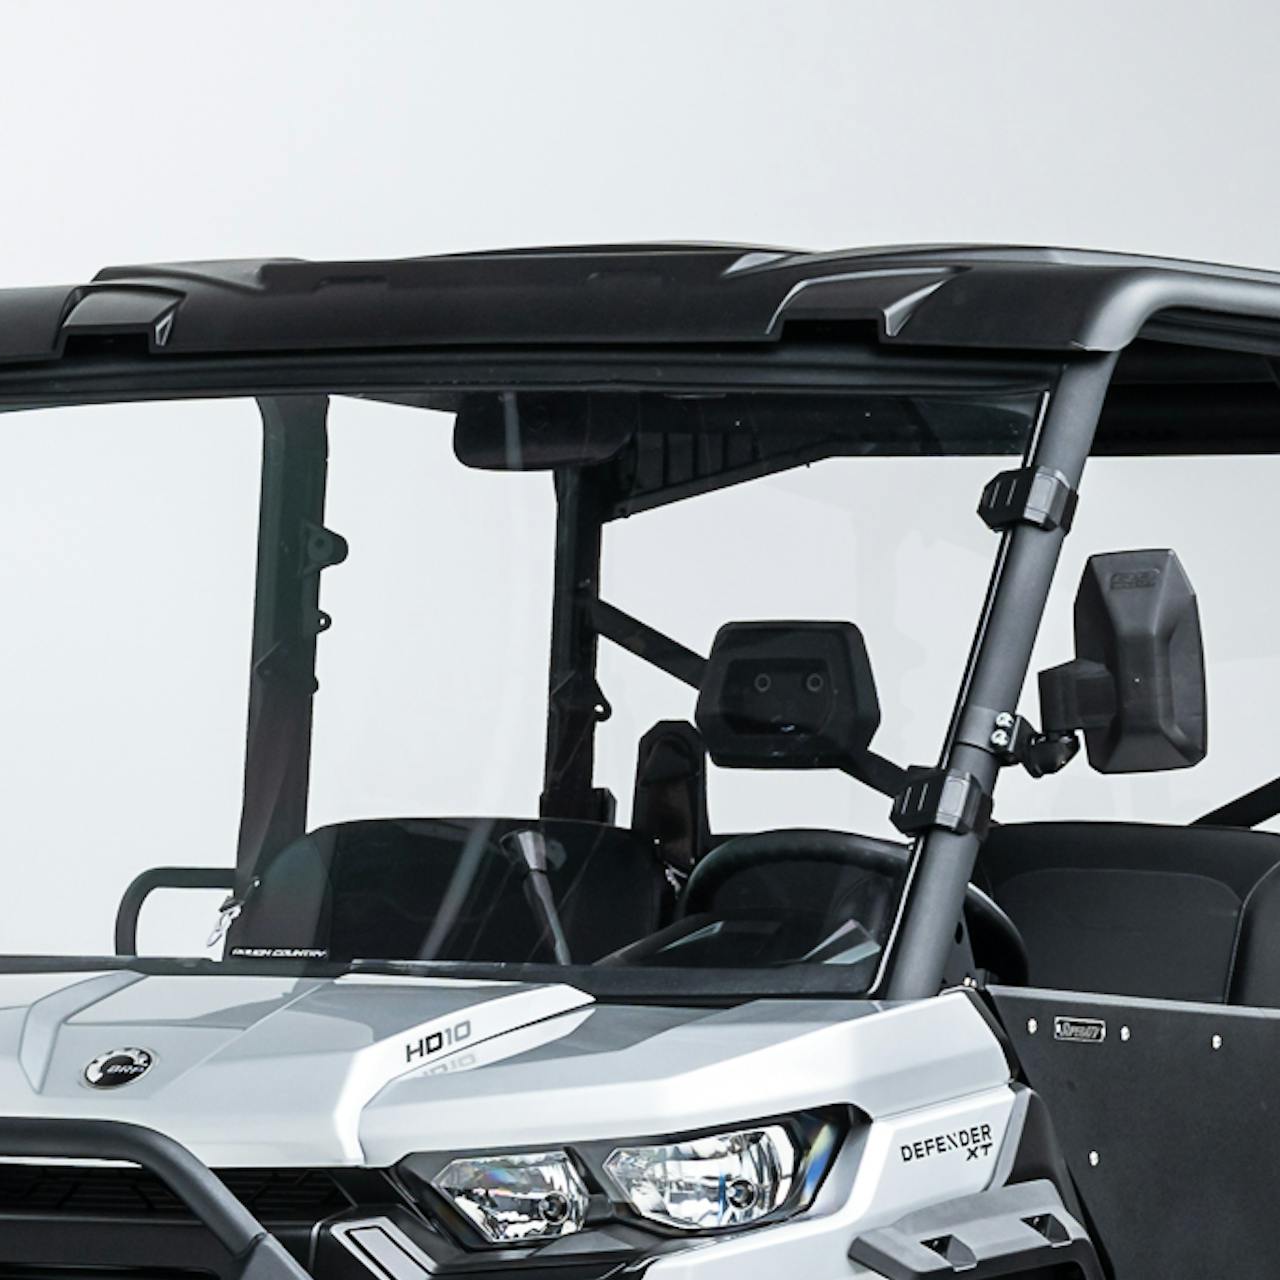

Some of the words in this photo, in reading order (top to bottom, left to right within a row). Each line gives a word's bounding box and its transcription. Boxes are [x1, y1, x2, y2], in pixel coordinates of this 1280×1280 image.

[406, 1020, 471, 1062] HD10
[107, 1063, 145, 1075] BRP
[901, 1124, 992, 1162] DEFENDER
[966, 1142, 993, 1162] XT
